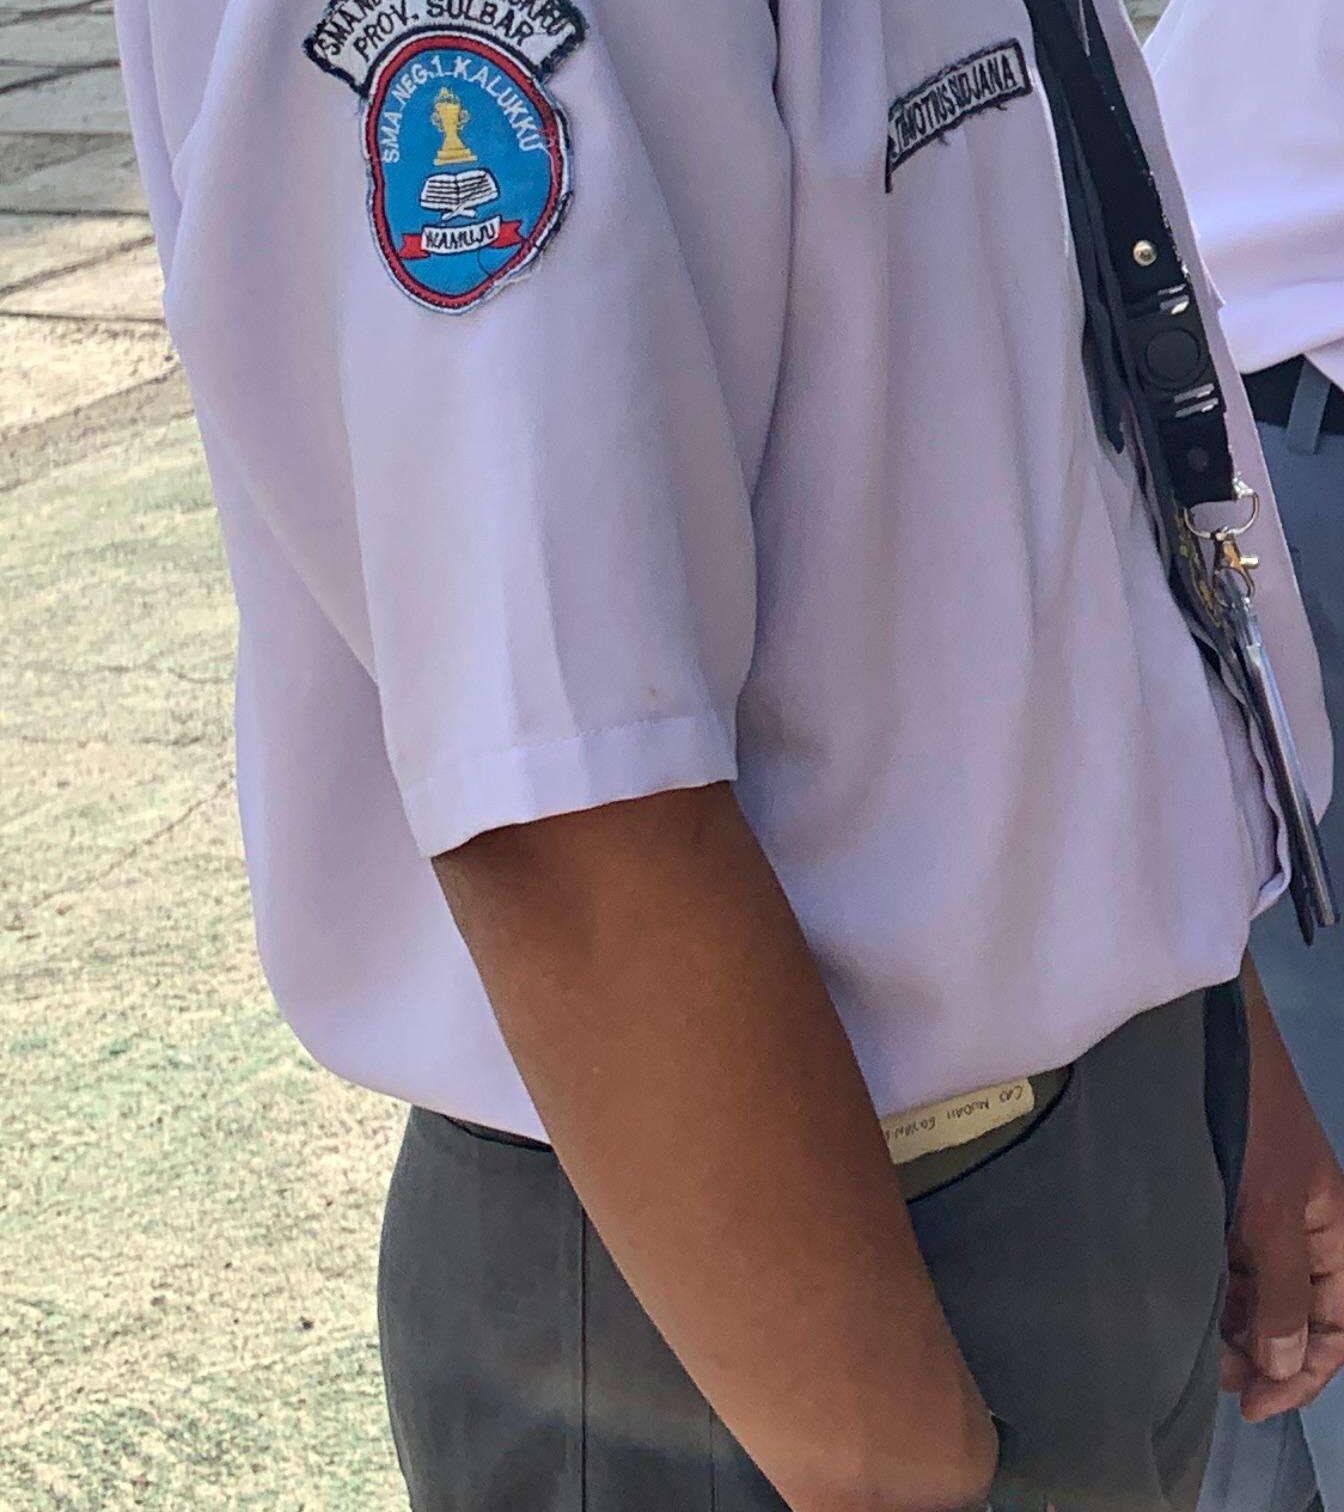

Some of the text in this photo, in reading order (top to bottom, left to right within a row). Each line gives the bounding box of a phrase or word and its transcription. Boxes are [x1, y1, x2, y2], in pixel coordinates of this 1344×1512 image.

[318, 3, 359, 56] SMA
[354, 0, 419, 63] PROV.
[380, 107, 404, 164] SMA
[453, 55, 542, 152] KALUKKU
